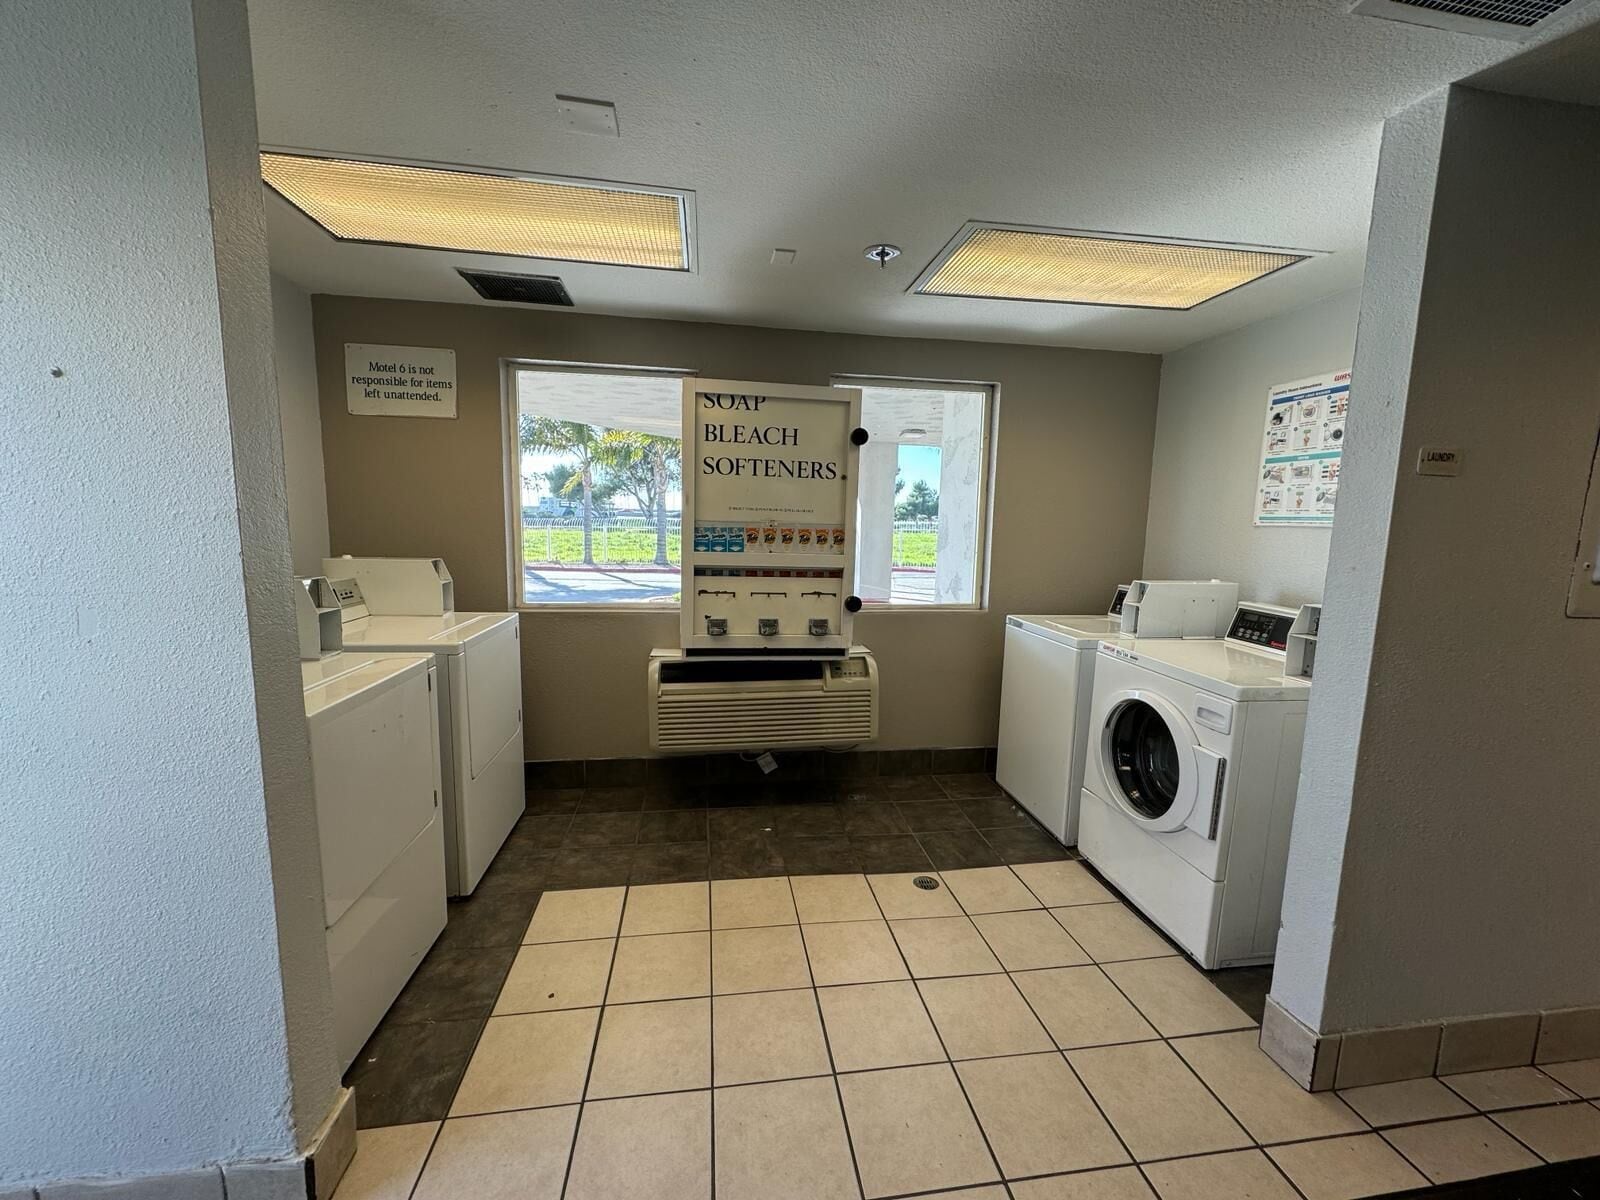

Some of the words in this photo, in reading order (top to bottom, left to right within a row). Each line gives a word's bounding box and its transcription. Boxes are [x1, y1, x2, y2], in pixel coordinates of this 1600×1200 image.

[369, 361, 396, 373] Motel
[399, 364, 406, 373] 6
[408, 364, 417, 374] is
[419, 366, 434, 375] not
[351, 375, 408, 387] responsible
[410, 377, 423, 387] for
[426, 378, 453, 389] items
[364, 388, 380, 398] left
[383, 391, 442, 402] unattended.
[703, 393, 767, 411] SOAP
[704, 423, 799, 446] BLEACH
[1426, 451, 1456, 462] LAUNDRY
[703, 456, 837, 480] SOFTENERS
